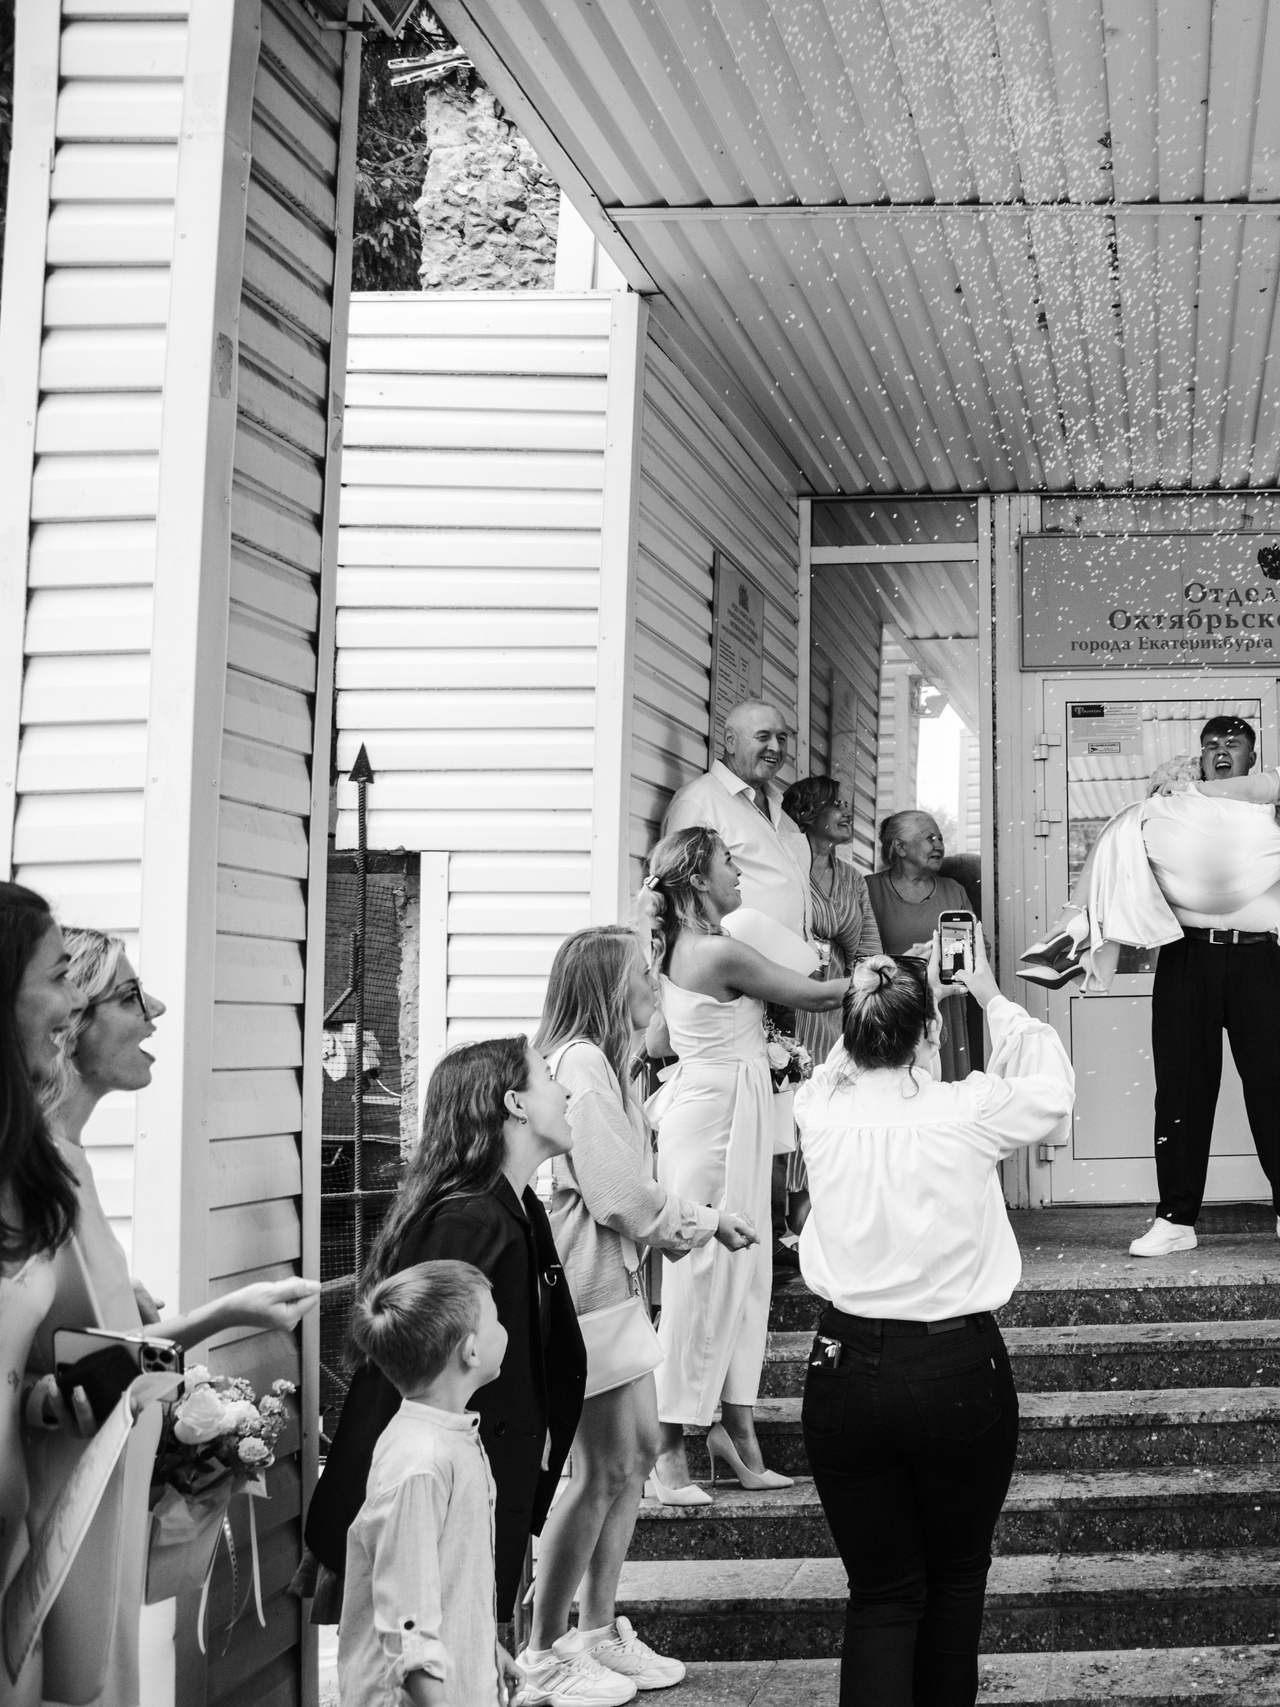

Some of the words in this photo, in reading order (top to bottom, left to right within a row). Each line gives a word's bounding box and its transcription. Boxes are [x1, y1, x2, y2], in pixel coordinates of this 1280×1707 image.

[1184, 583, 1278, 607] Отдел
[1070, 639, 1131, 653] города
[1138, 635, 1273, 652] Екатеринбурга
